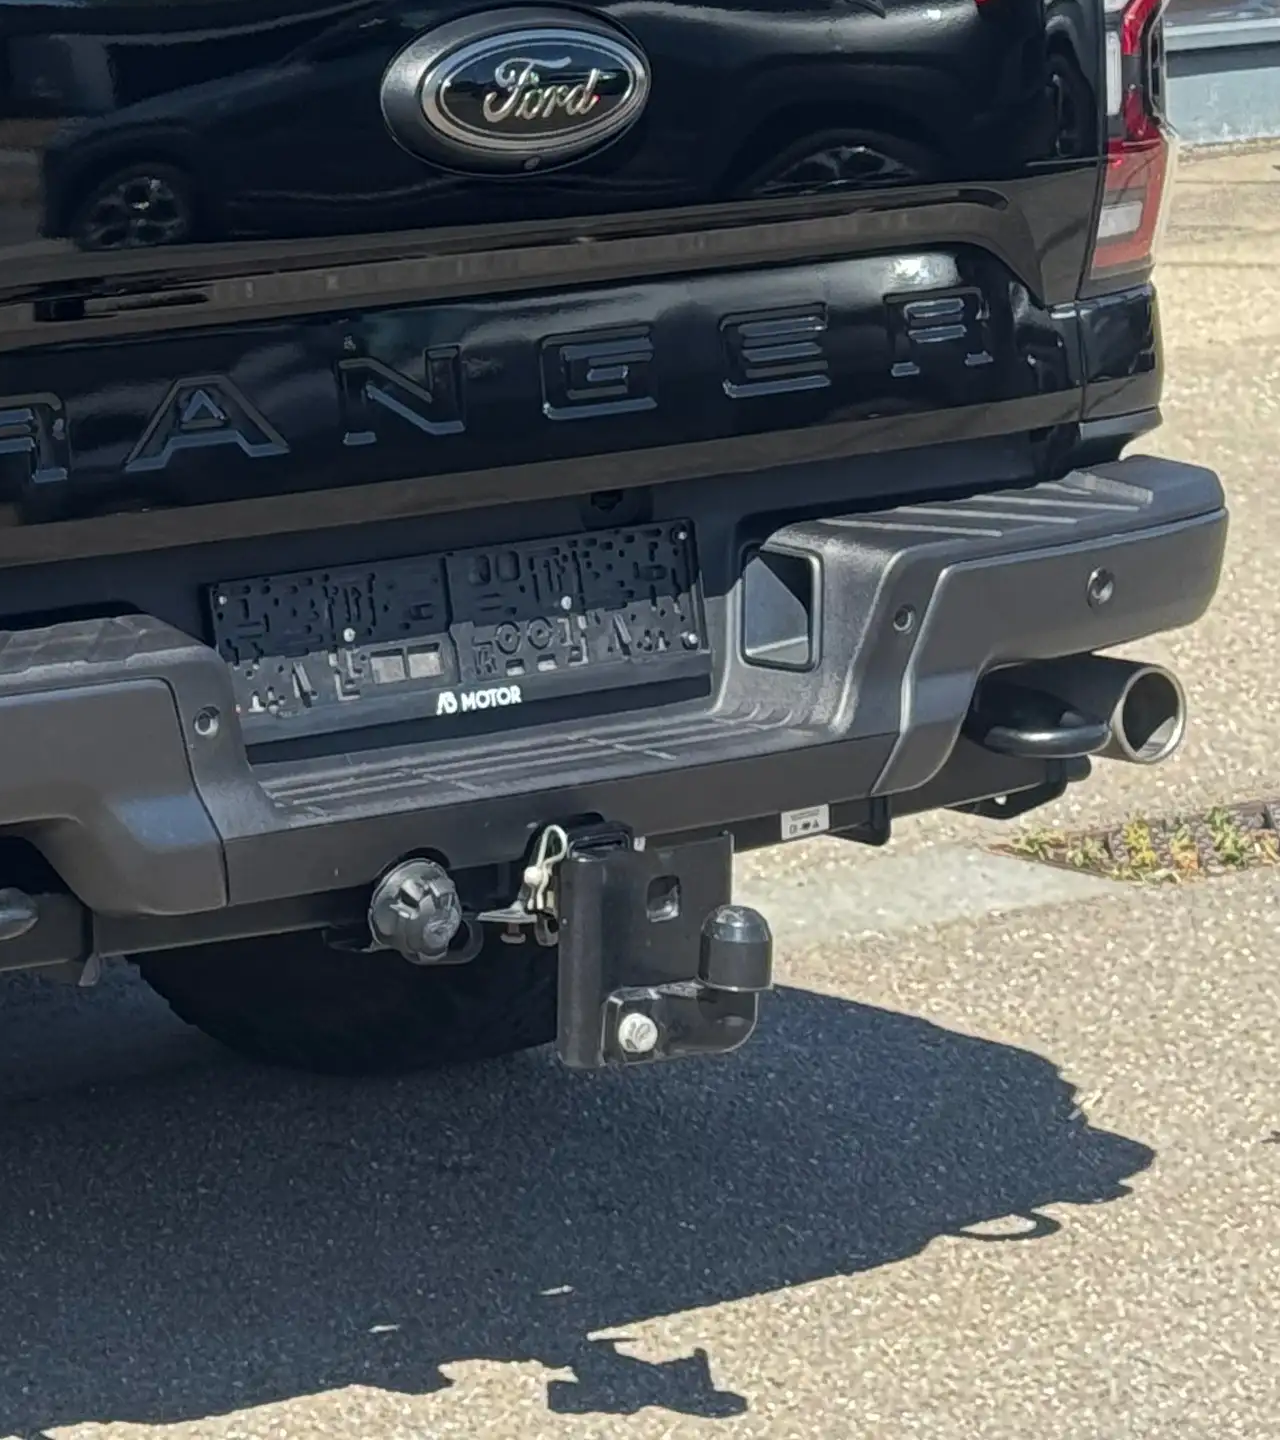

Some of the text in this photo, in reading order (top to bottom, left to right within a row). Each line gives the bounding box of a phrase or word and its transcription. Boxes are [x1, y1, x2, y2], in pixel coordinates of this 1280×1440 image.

[482, 56, 600, 123] Ford
[435, 684, 522, 715] AB MOTOR
